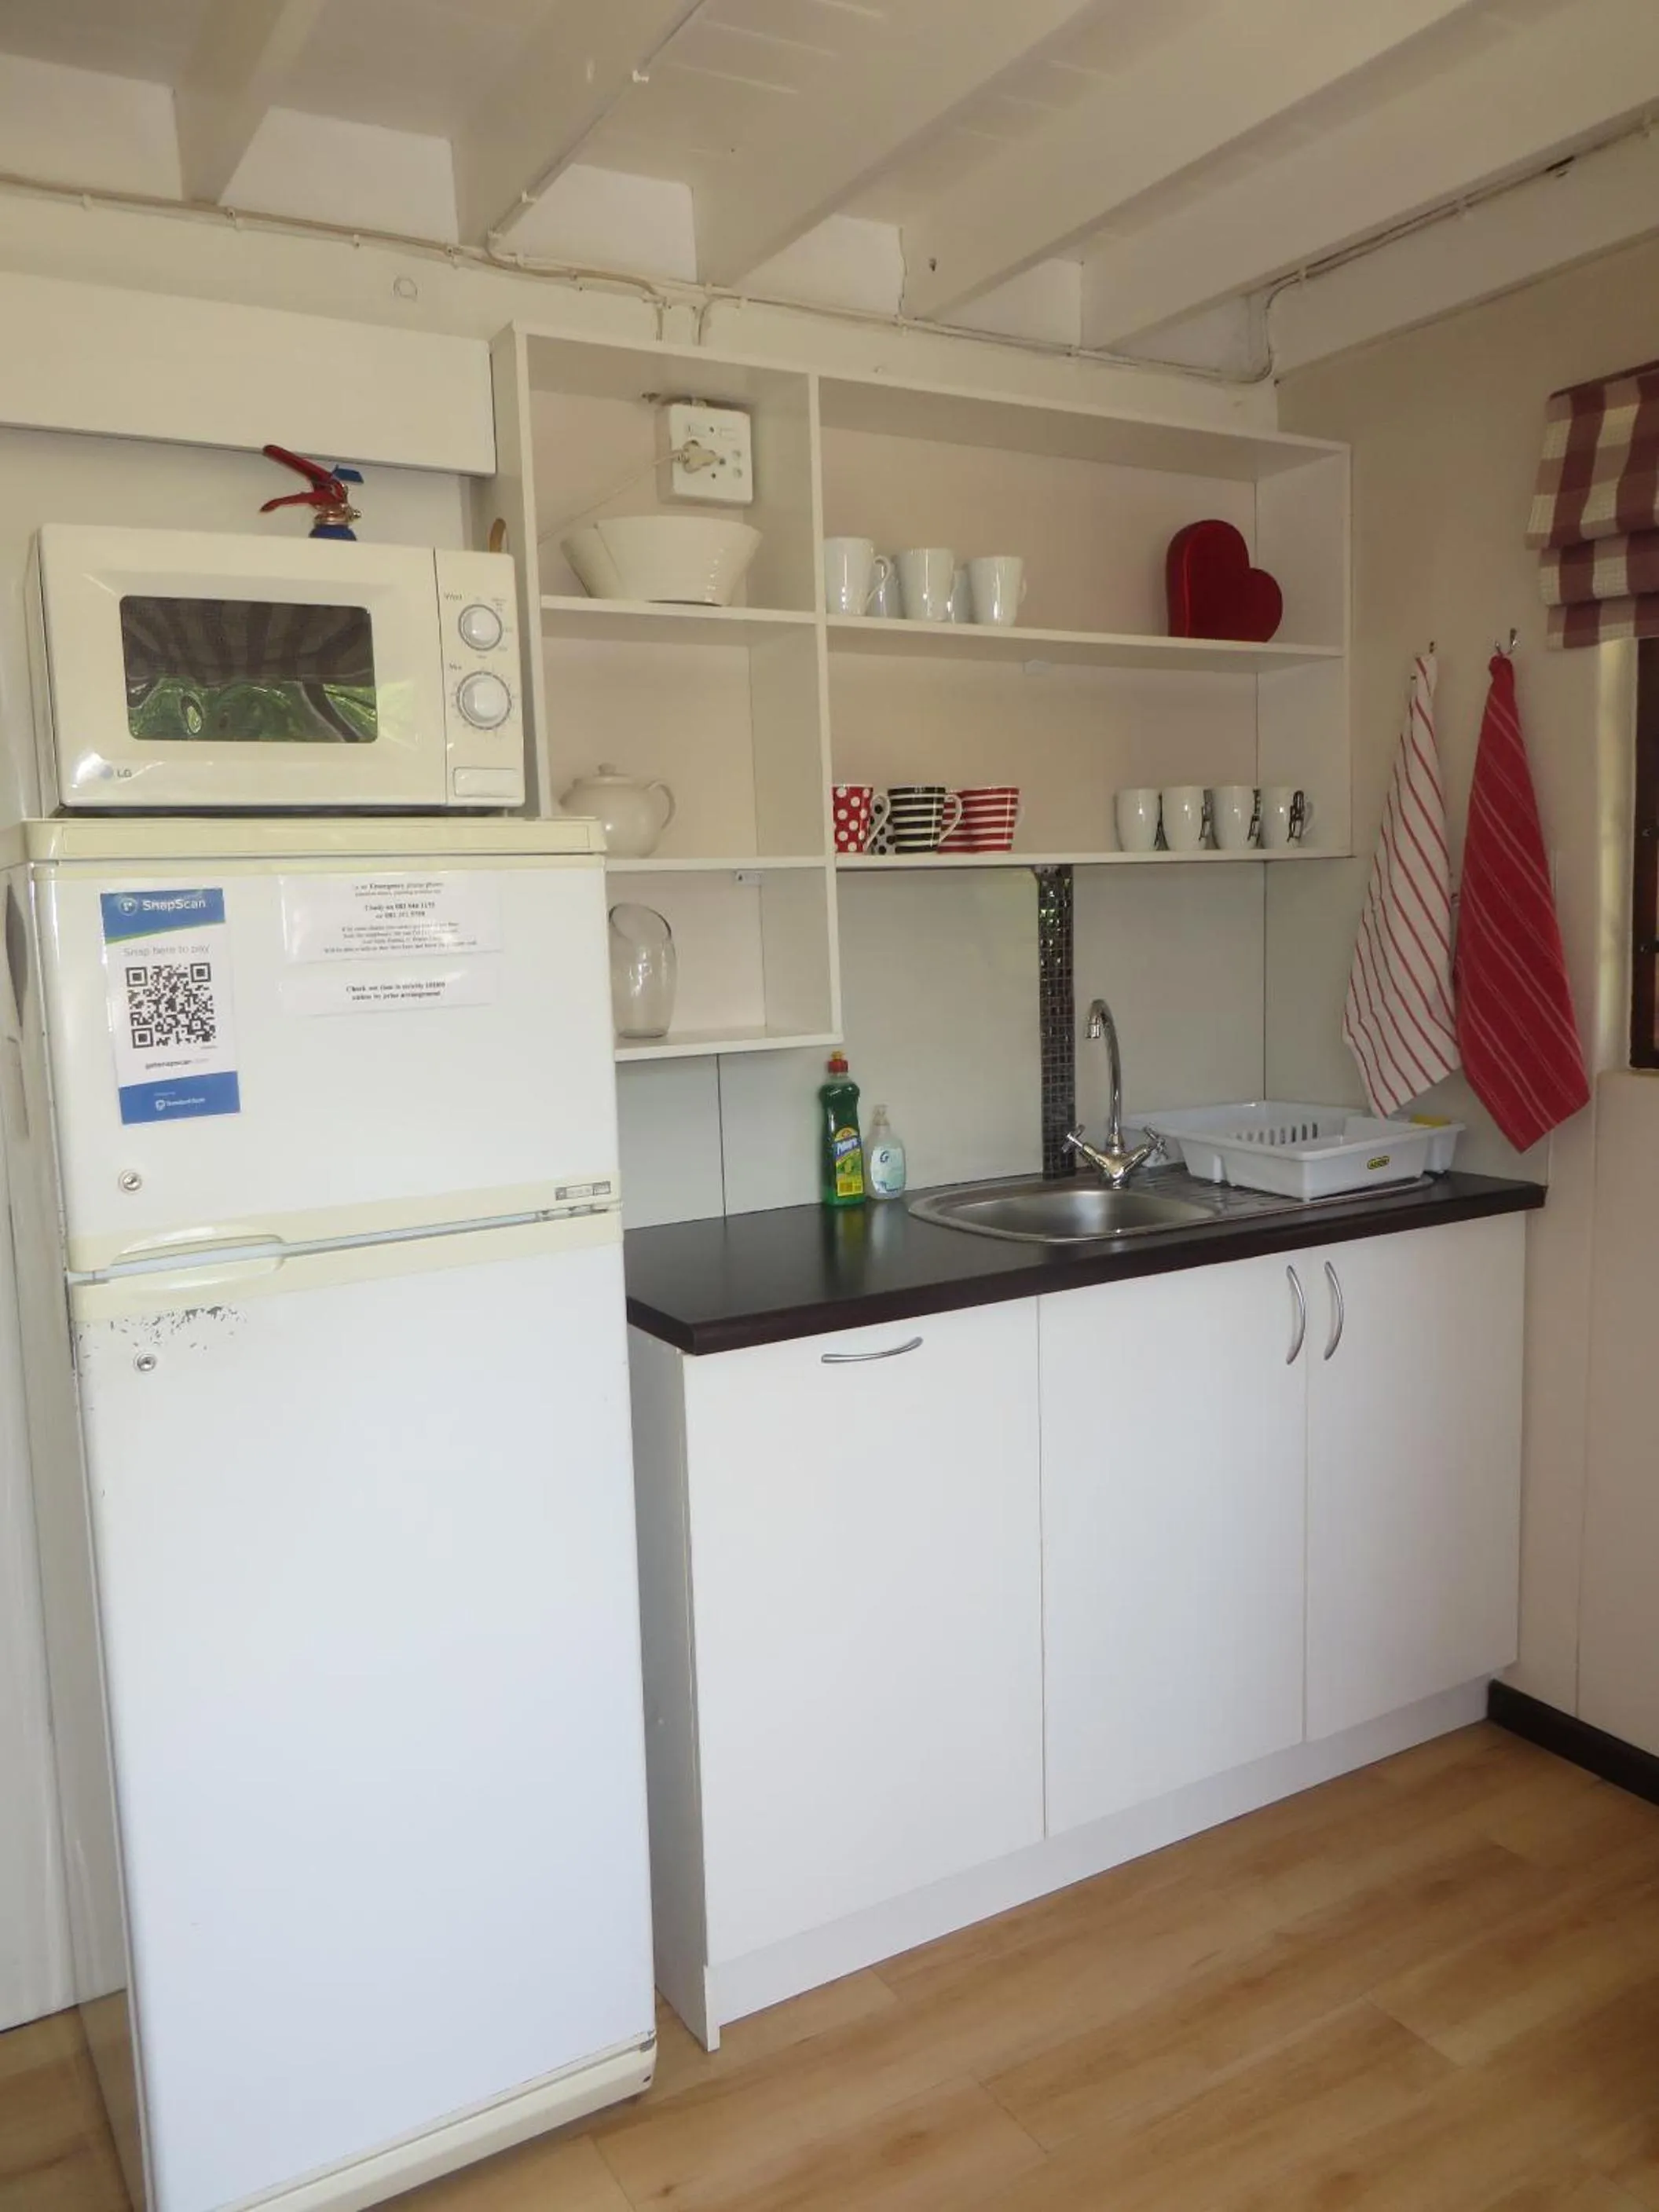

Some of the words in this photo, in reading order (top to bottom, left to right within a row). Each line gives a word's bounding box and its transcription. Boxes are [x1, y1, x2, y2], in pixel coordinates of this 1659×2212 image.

[117, 769, 132, 778] LG
[141, 898, 206, 914] SnapScan
[123, 947, 151, 958] Snap
[152, 945, 176, 955] here
[179, 945, 189, 954] to
[346, 984, 366, 993] Check
